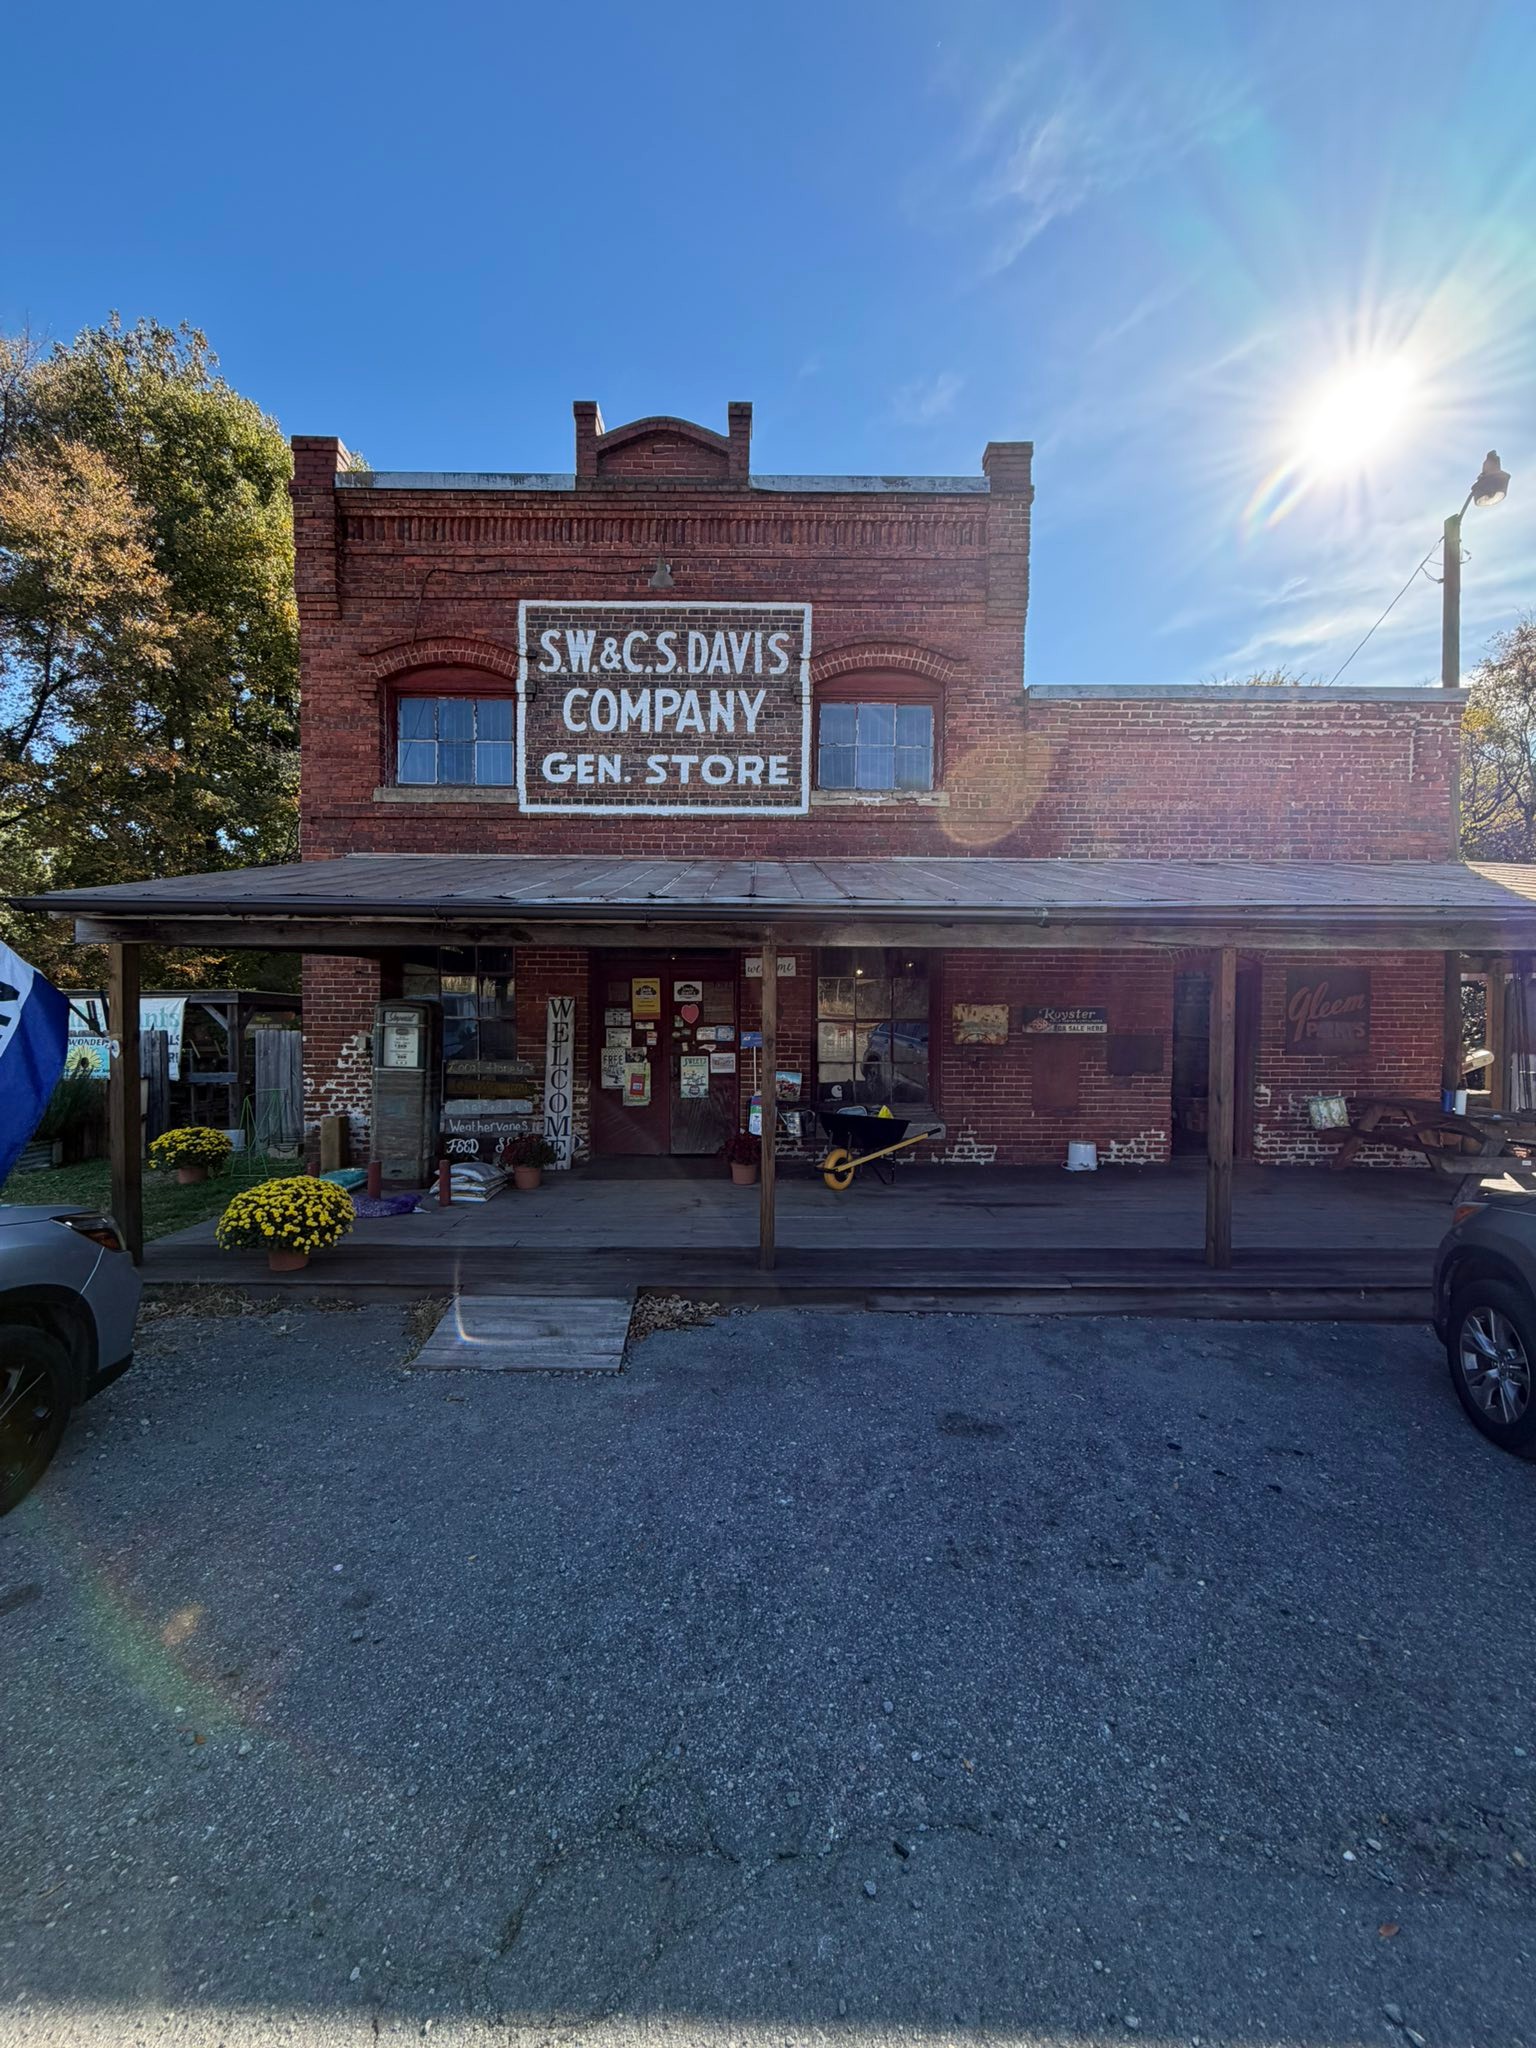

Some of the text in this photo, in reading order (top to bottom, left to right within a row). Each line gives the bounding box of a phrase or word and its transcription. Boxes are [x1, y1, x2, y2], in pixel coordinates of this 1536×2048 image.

[563, 687, 766, 734] COMPANY
[541, 751, 790, 785] GEN. STORE
[1038, 1008, 1097, 1021] Royster
[545, 998, 574, 1161] WELCOME
[445, 1138, 480, 1154] FEED
